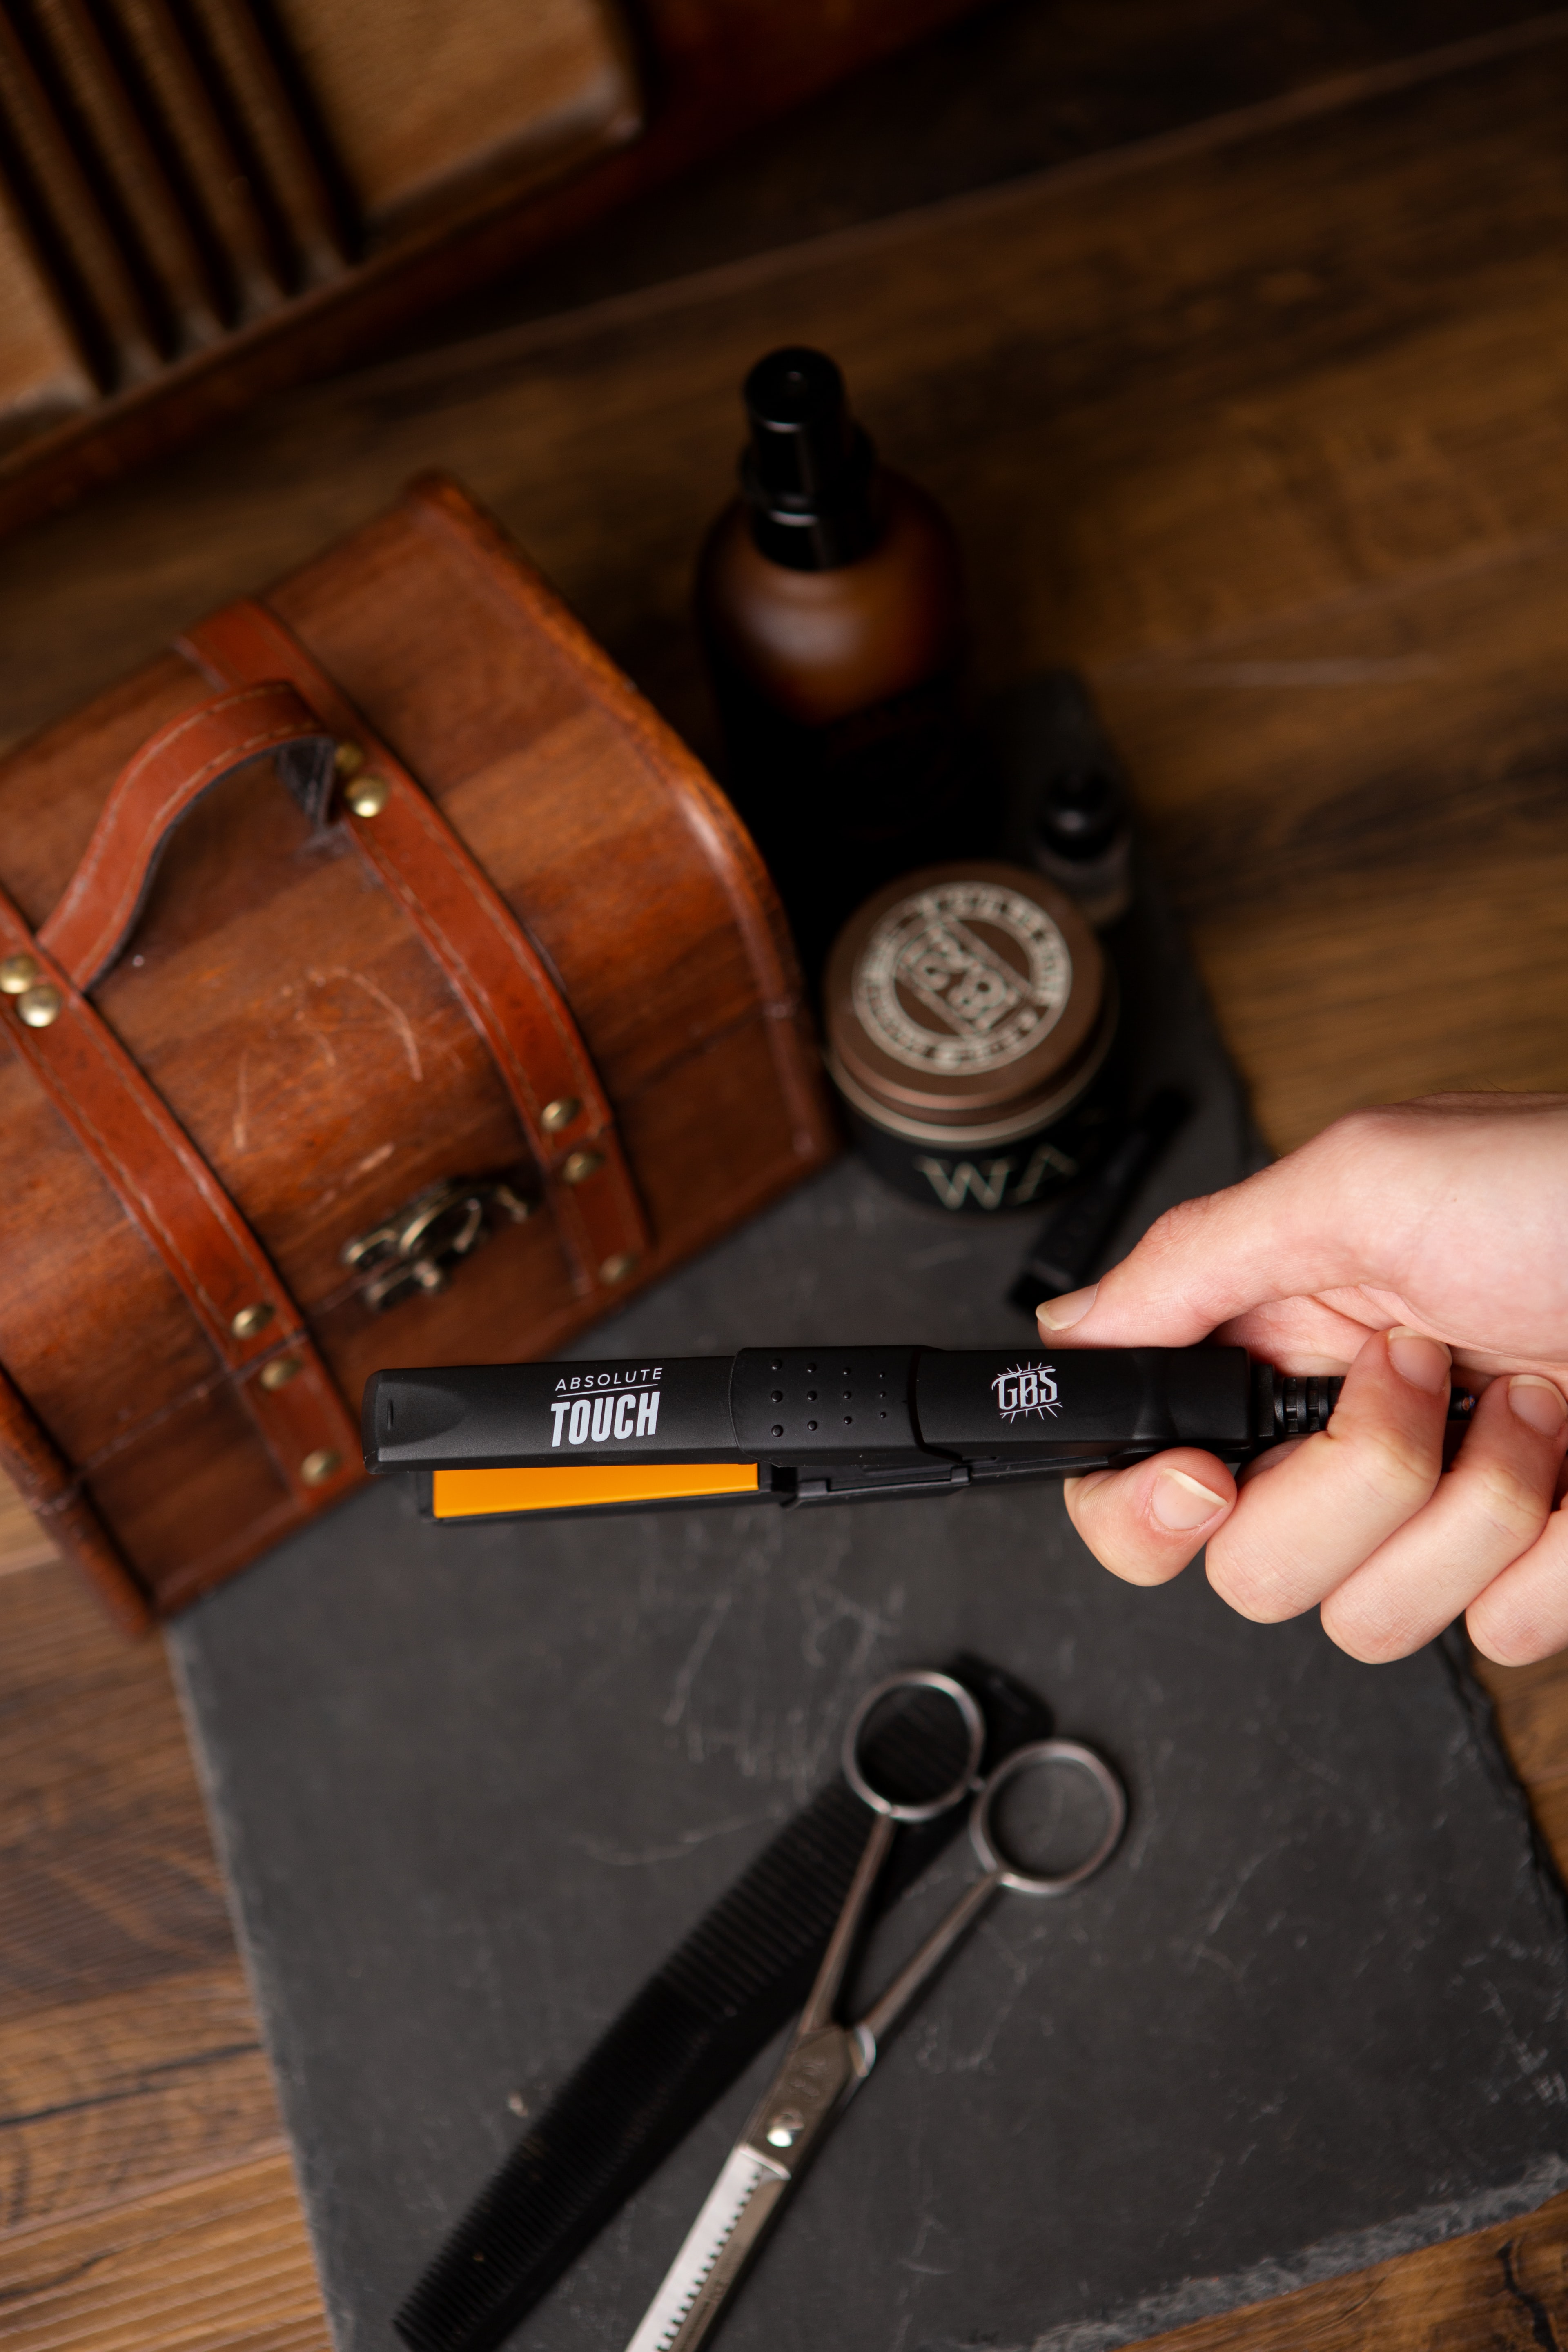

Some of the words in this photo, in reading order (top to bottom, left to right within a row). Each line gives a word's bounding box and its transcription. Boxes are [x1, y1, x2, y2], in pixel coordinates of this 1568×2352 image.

[555, 1368, 663, 1391] ABSOLUTE
[991, 1368, 1058, 1410] GBS
[551, 1391, 660, 1447] TOUCH
